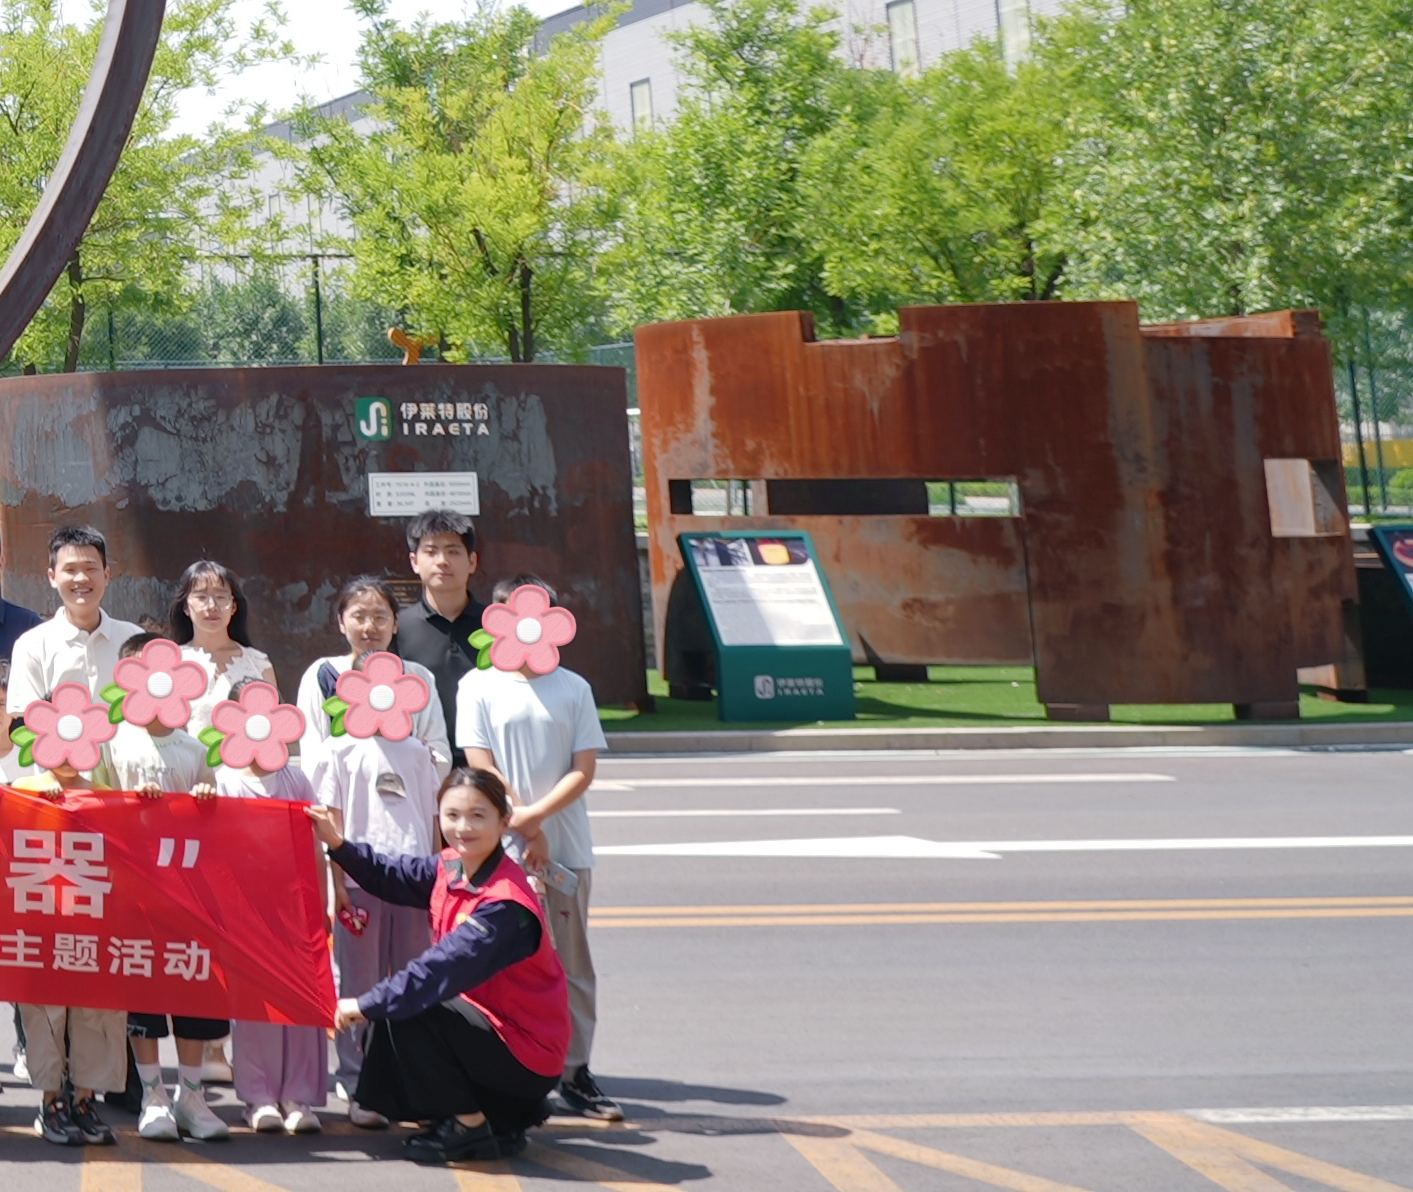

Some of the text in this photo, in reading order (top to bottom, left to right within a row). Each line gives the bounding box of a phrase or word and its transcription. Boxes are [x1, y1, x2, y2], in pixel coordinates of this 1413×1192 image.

[399, 402, 489, 420] 伊莱特股份
[402, 422, 490, 436] IRAETA
